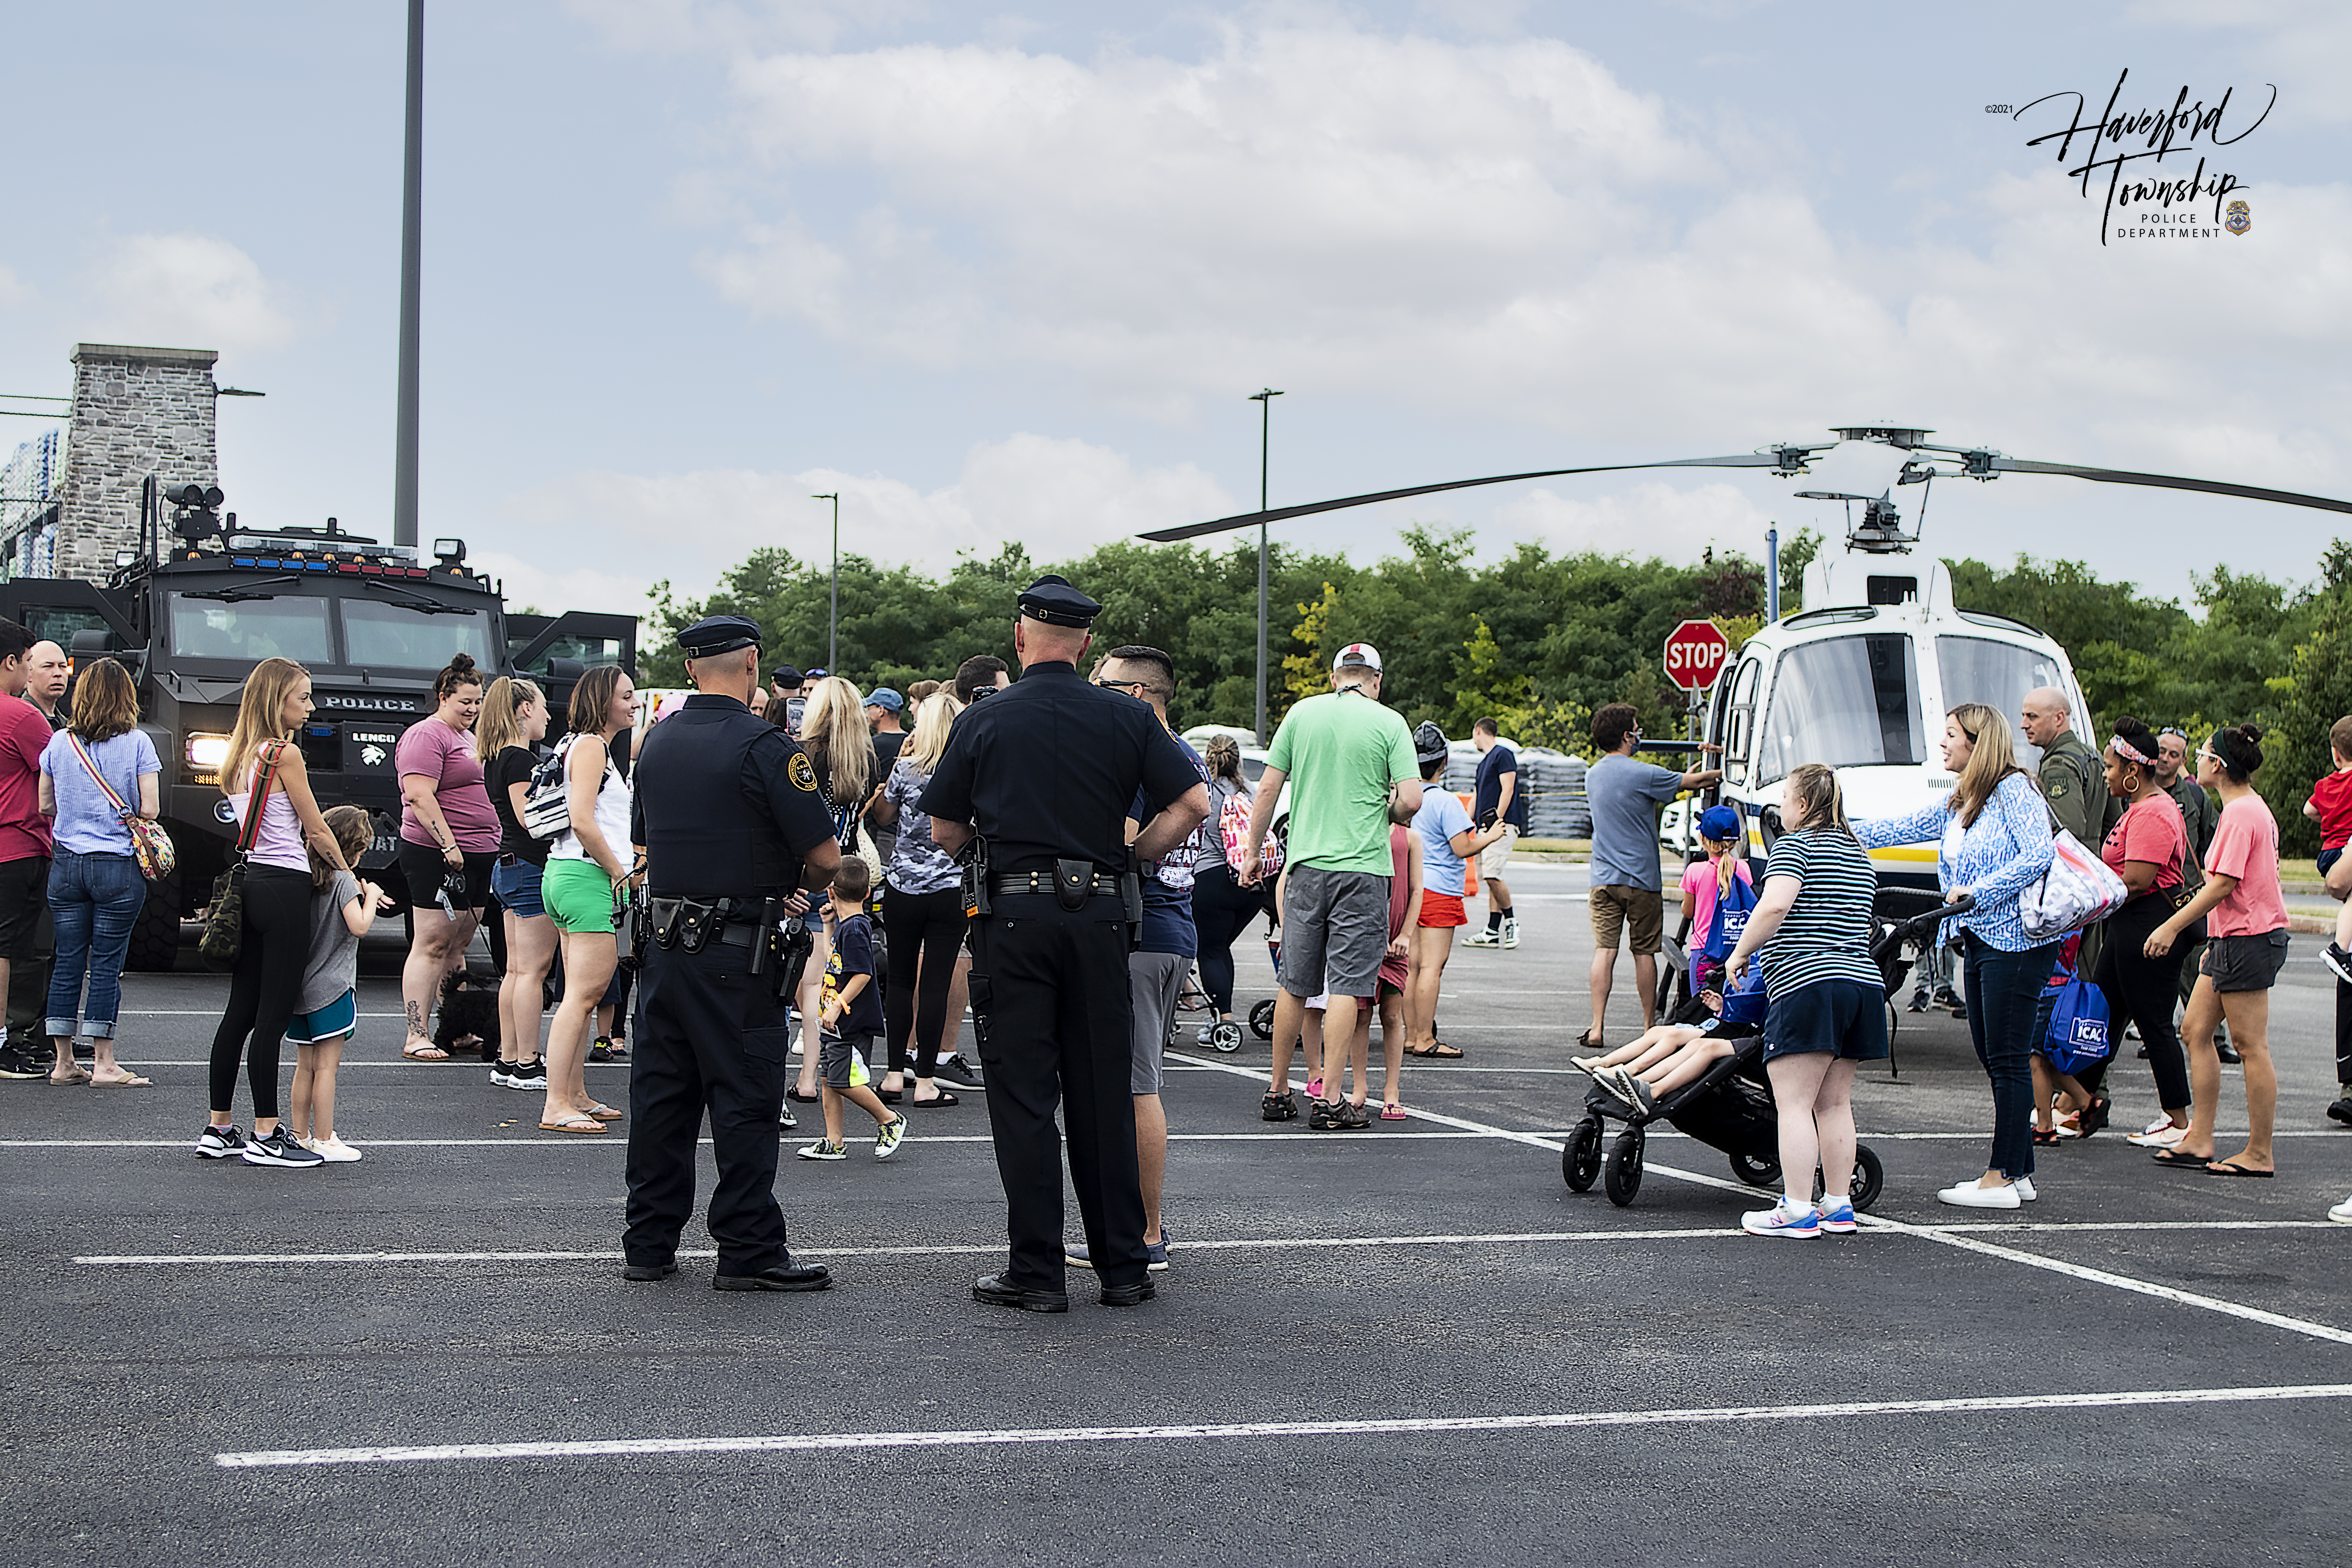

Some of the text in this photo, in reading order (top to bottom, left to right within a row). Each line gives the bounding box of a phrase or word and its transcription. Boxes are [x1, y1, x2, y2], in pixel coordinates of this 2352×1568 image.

[1669, 642, 1724, 669] STOP
[325, 696, 415, 711] POLICE
[352, 733, 396, 743] LENCO
[2077, 1025, 2102, 1042] ICAC
